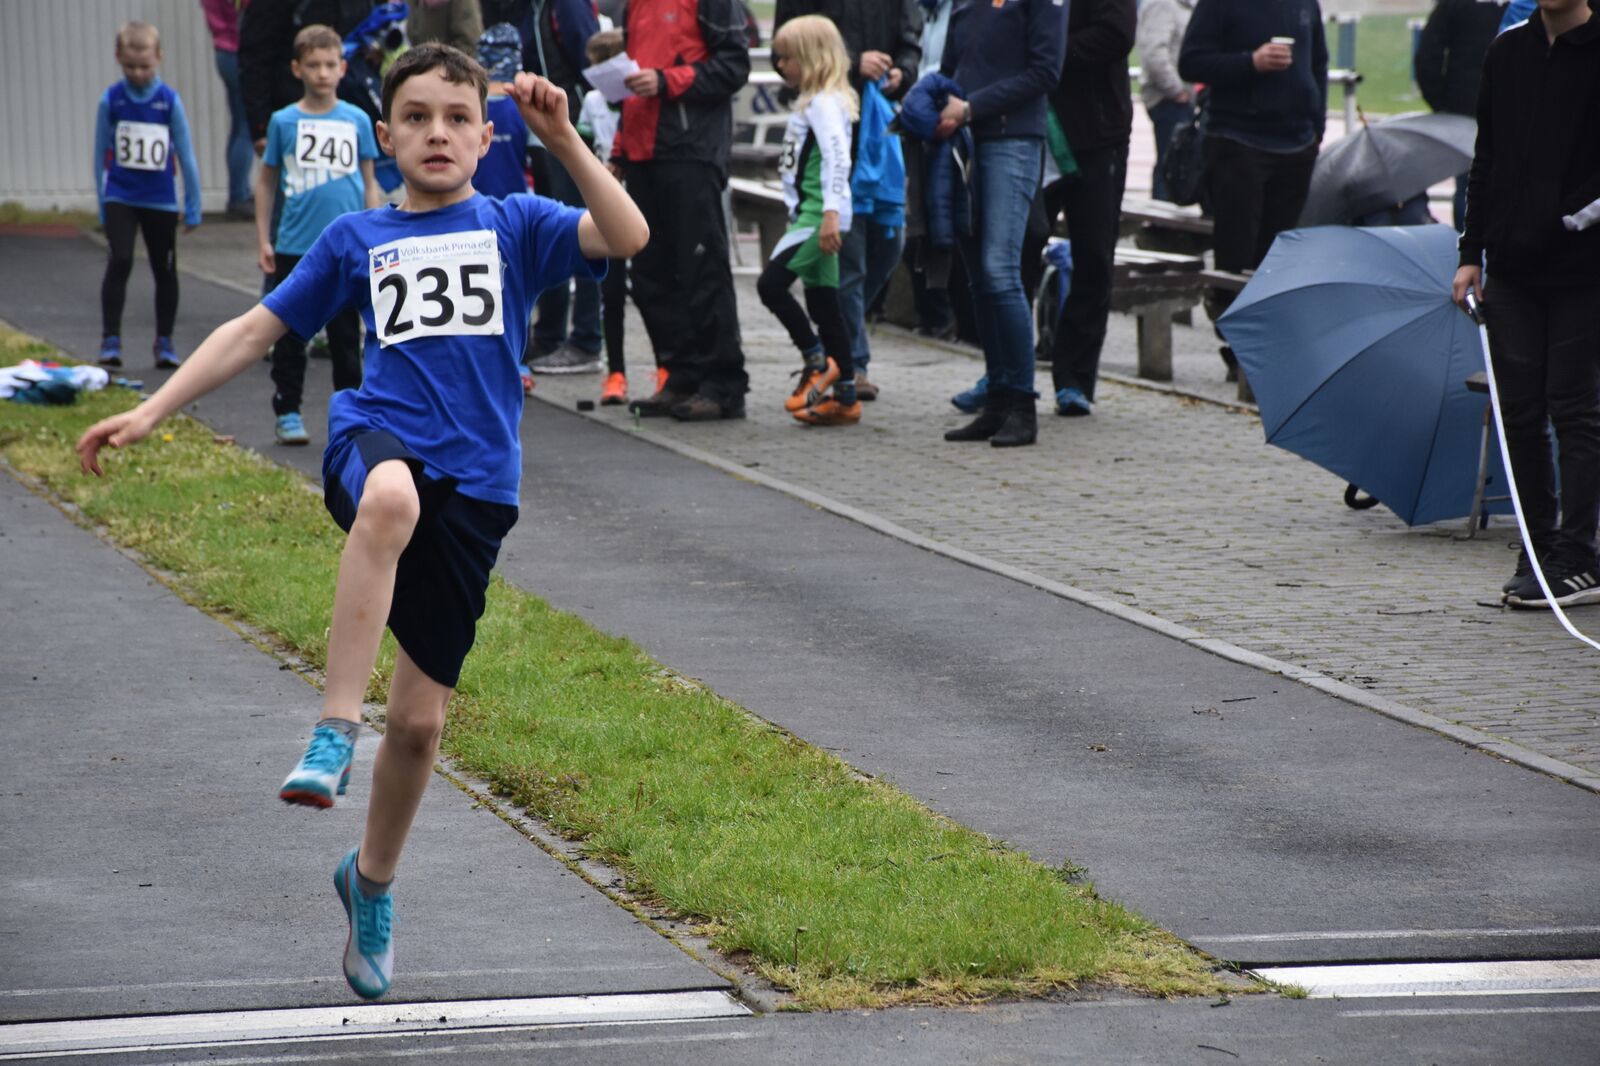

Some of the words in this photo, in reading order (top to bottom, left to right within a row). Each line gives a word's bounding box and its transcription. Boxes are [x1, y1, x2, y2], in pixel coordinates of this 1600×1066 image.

[119, 136, 166, 166] 310
[301, 134, 354, 168] 240
[400, 243, 450, 257] Volksbank
[451, 241, 477, 250] Pirna
[478, 239, 492, 249] eG
[378, 264, 495, 337] 235
